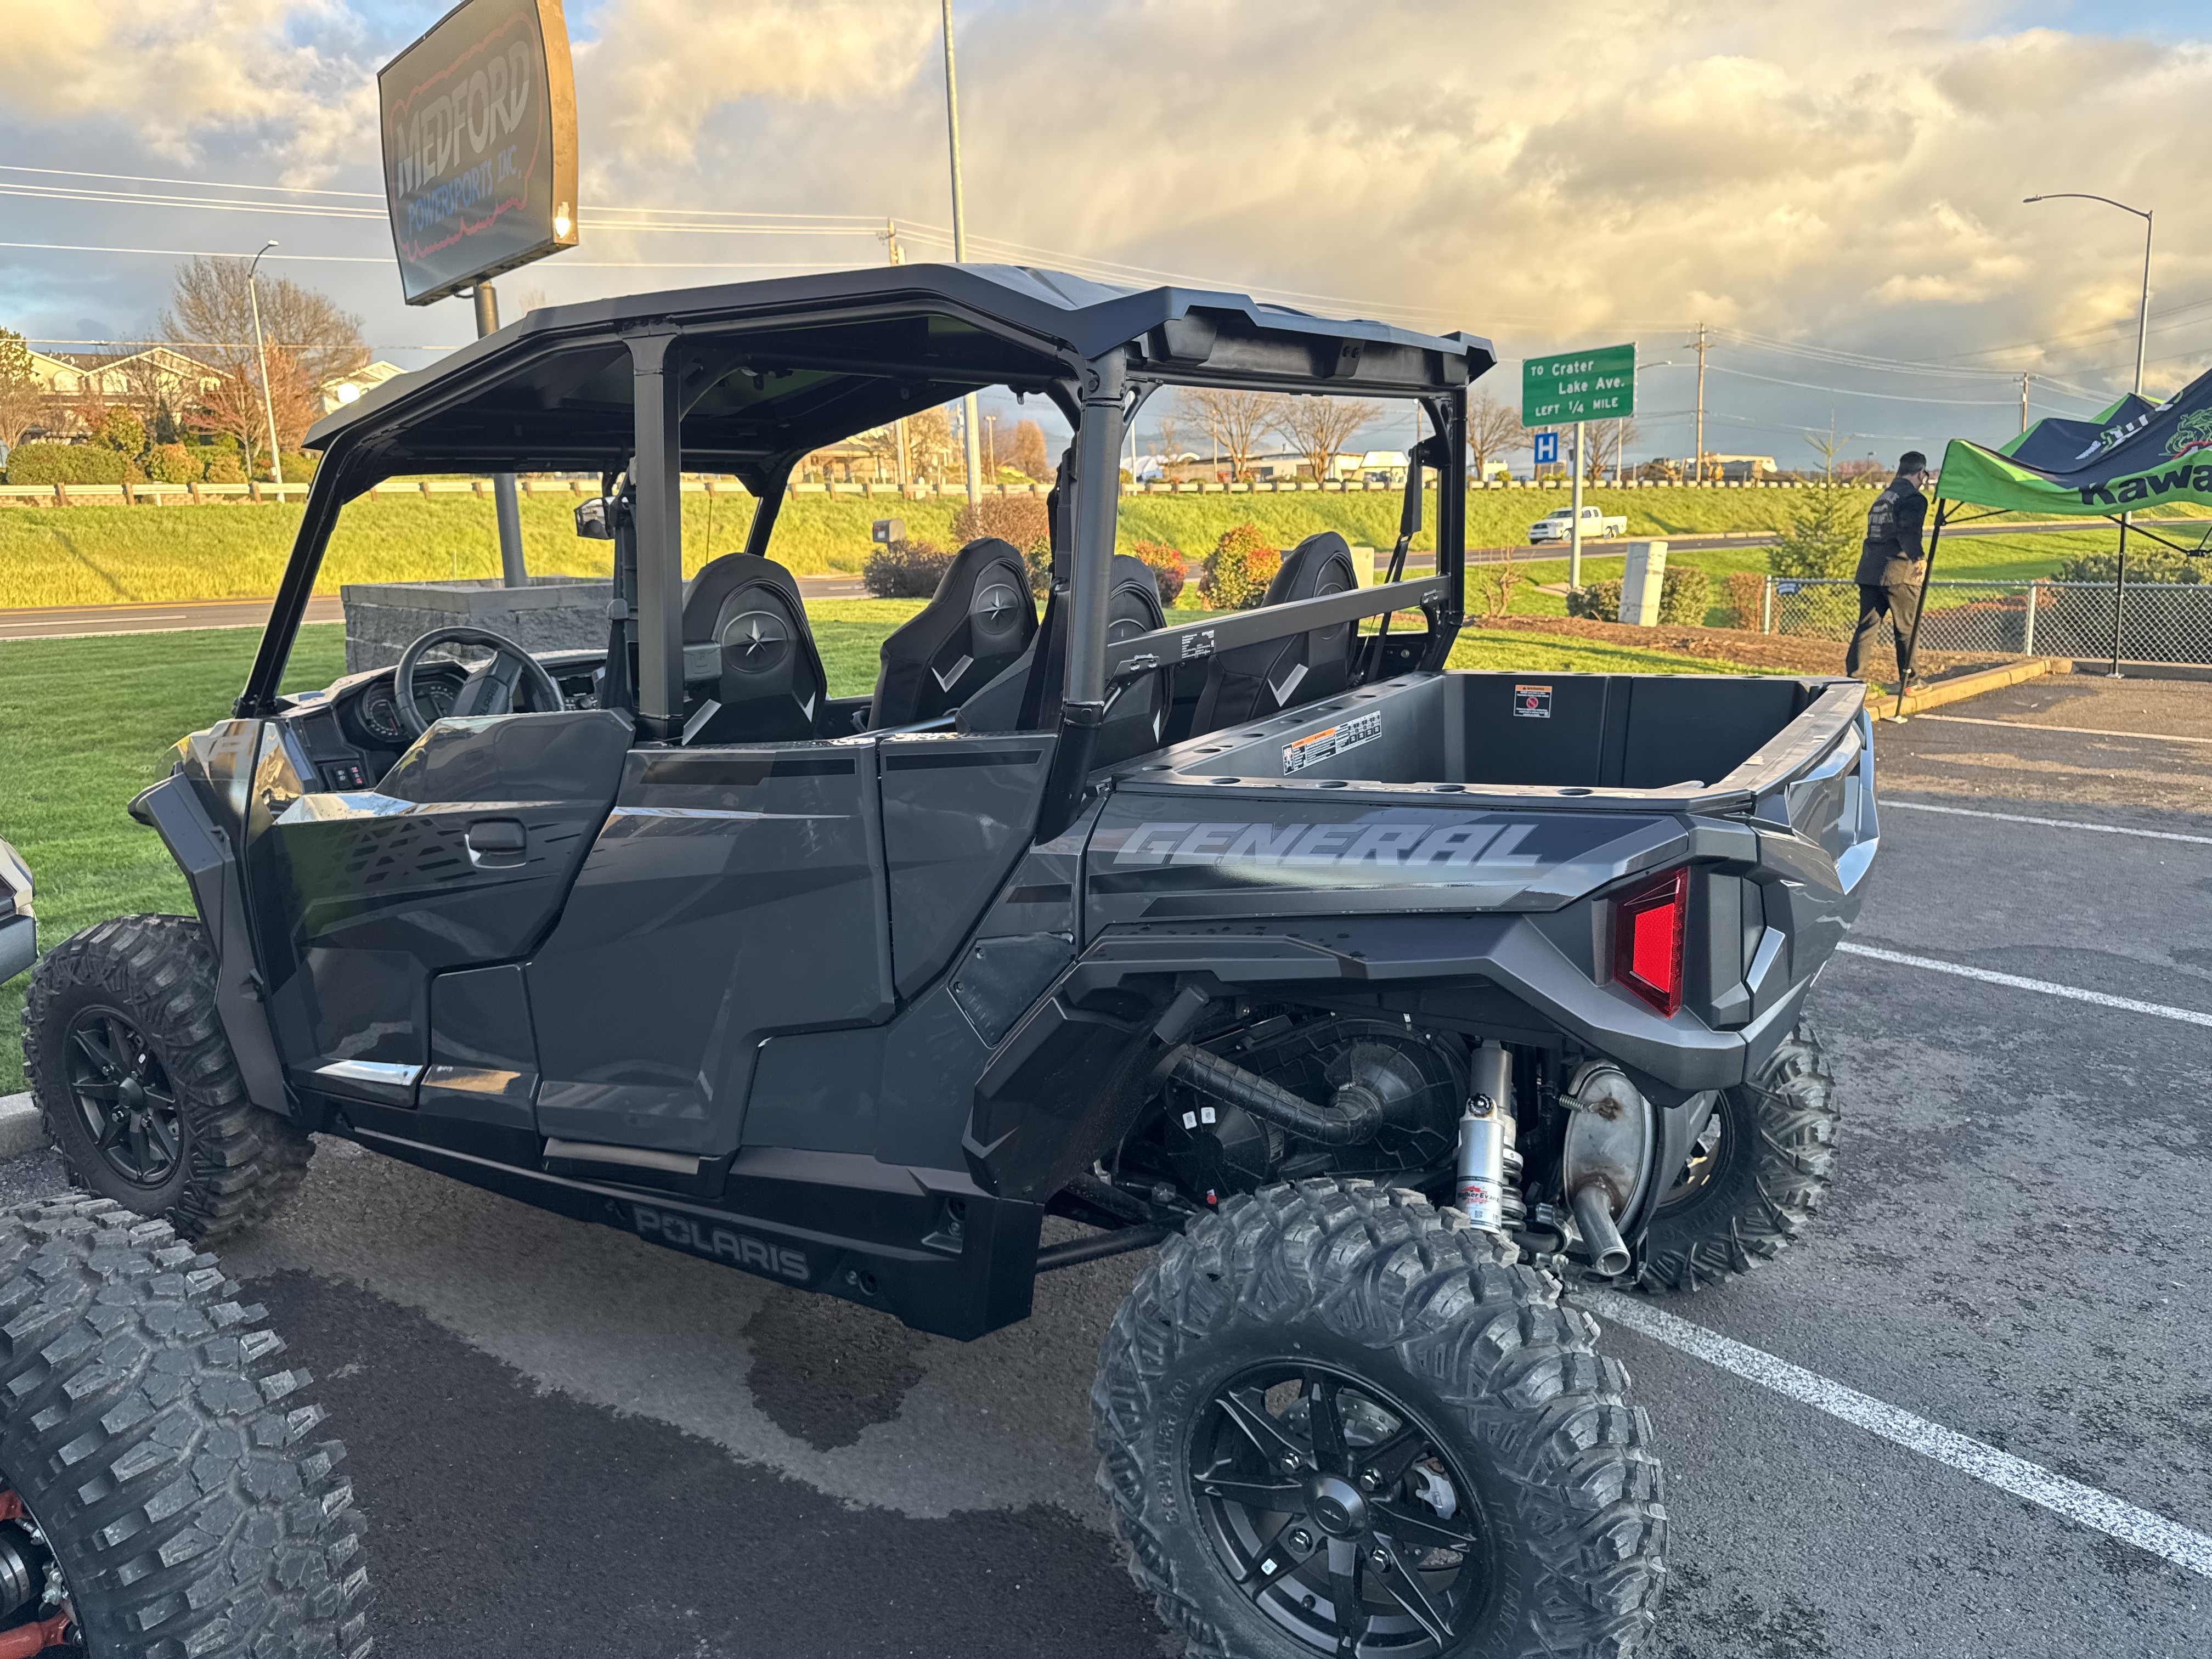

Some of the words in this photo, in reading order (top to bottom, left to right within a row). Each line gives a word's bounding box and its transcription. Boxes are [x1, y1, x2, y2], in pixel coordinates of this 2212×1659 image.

[397, 40, 530, 199] MEDFORD
[407, 158, 493, 237] POWERSPORTS
[1551, 360, 1594, 376] Crater
[1559, 380, 1588, 395] Lake
[1595, 376, 1624, 390] Ave.
[1535, 404, 1560, 417] LEFT
[1568, 400, 1584, 414] 1/4
[1593, 397, 1618, 410] MILE
[1538, 436, 1554, 460] H
[1113, 822, 1543, 867] GENERAL
[633, 1205, 810, 1280] POLARIS
